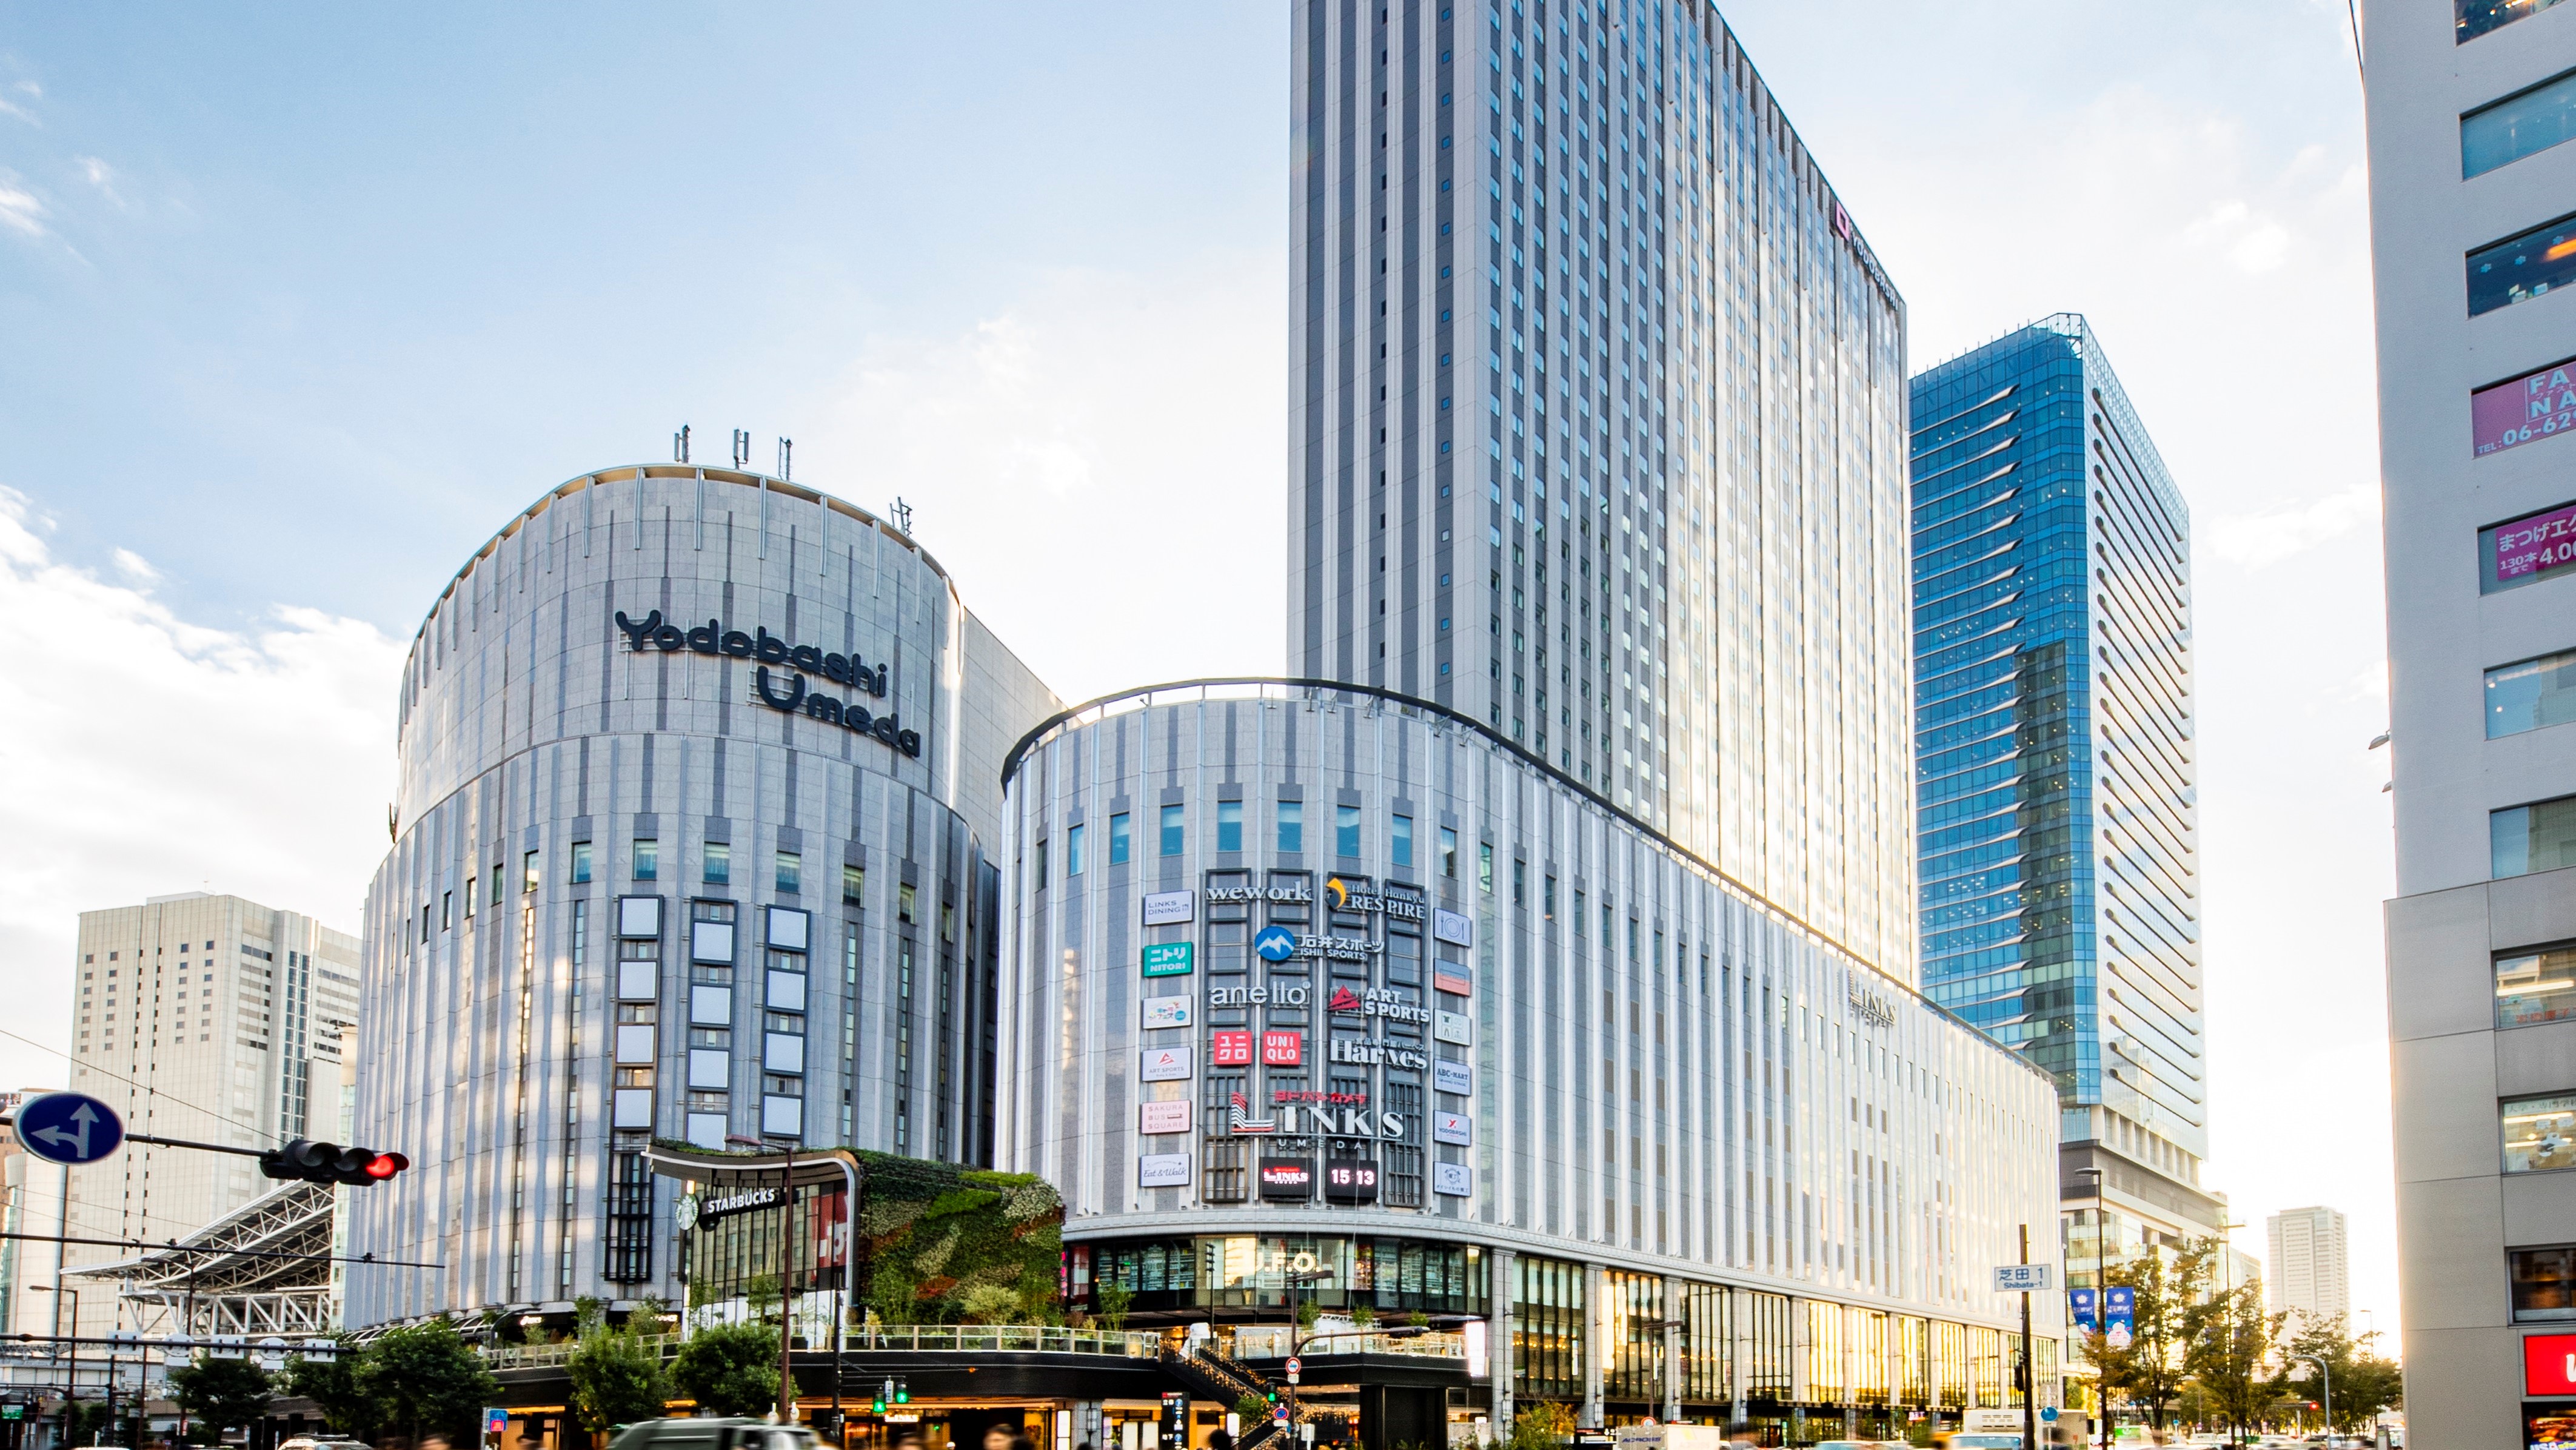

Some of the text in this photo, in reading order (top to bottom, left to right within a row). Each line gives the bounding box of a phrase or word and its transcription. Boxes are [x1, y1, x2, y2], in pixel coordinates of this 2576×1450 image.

[2529, 365, 2576, 395] FA
[615, 609, 888, 697] Yodobashi
[757, 665, 921, 757] Umeda
[1206, 881, 1313, 901] wework
[1351, 885, 1425, 904] Hotel Hankyu
[1148, 907, 1181, 915] DINING
[1351, 895, 1425, 919] RESPIRE
[1150, 947, 1186, 962] ニトリ
[1300, 947, 1367, 961] ISHII SPORTS
[1150, 962, 1186, 972] NITORI
[1366, 987, 1402, 1004] ART
[1365, 1001, 1430, 1022] SPORTS
[1267, 1035, 1293, 1047] UNI
[1266, 1049, 1296, 1061] QLO
[1330, 1039, 1427, 1069] Harves
[1437, 1068, 1468, 1079] ABC-MART
[1231, 1092, 1403, 1138] LINKS
[1439, 1127, 1467, 1136] YODOBASHI
[1278, 1138, 1363, 1150] UMEDA
[1143, 1169, 1156, 1178] Eat
[1163, 1167, 1186, 1176] Walk
[1263, 1169, 1309, 1182] LINKS
[708, 1189, 775, 1213] STARBUCKS
[1999, 1267, 2043, 1281] 芝田 1
[2004, 1280, 2042, 1289] Shibata-1
